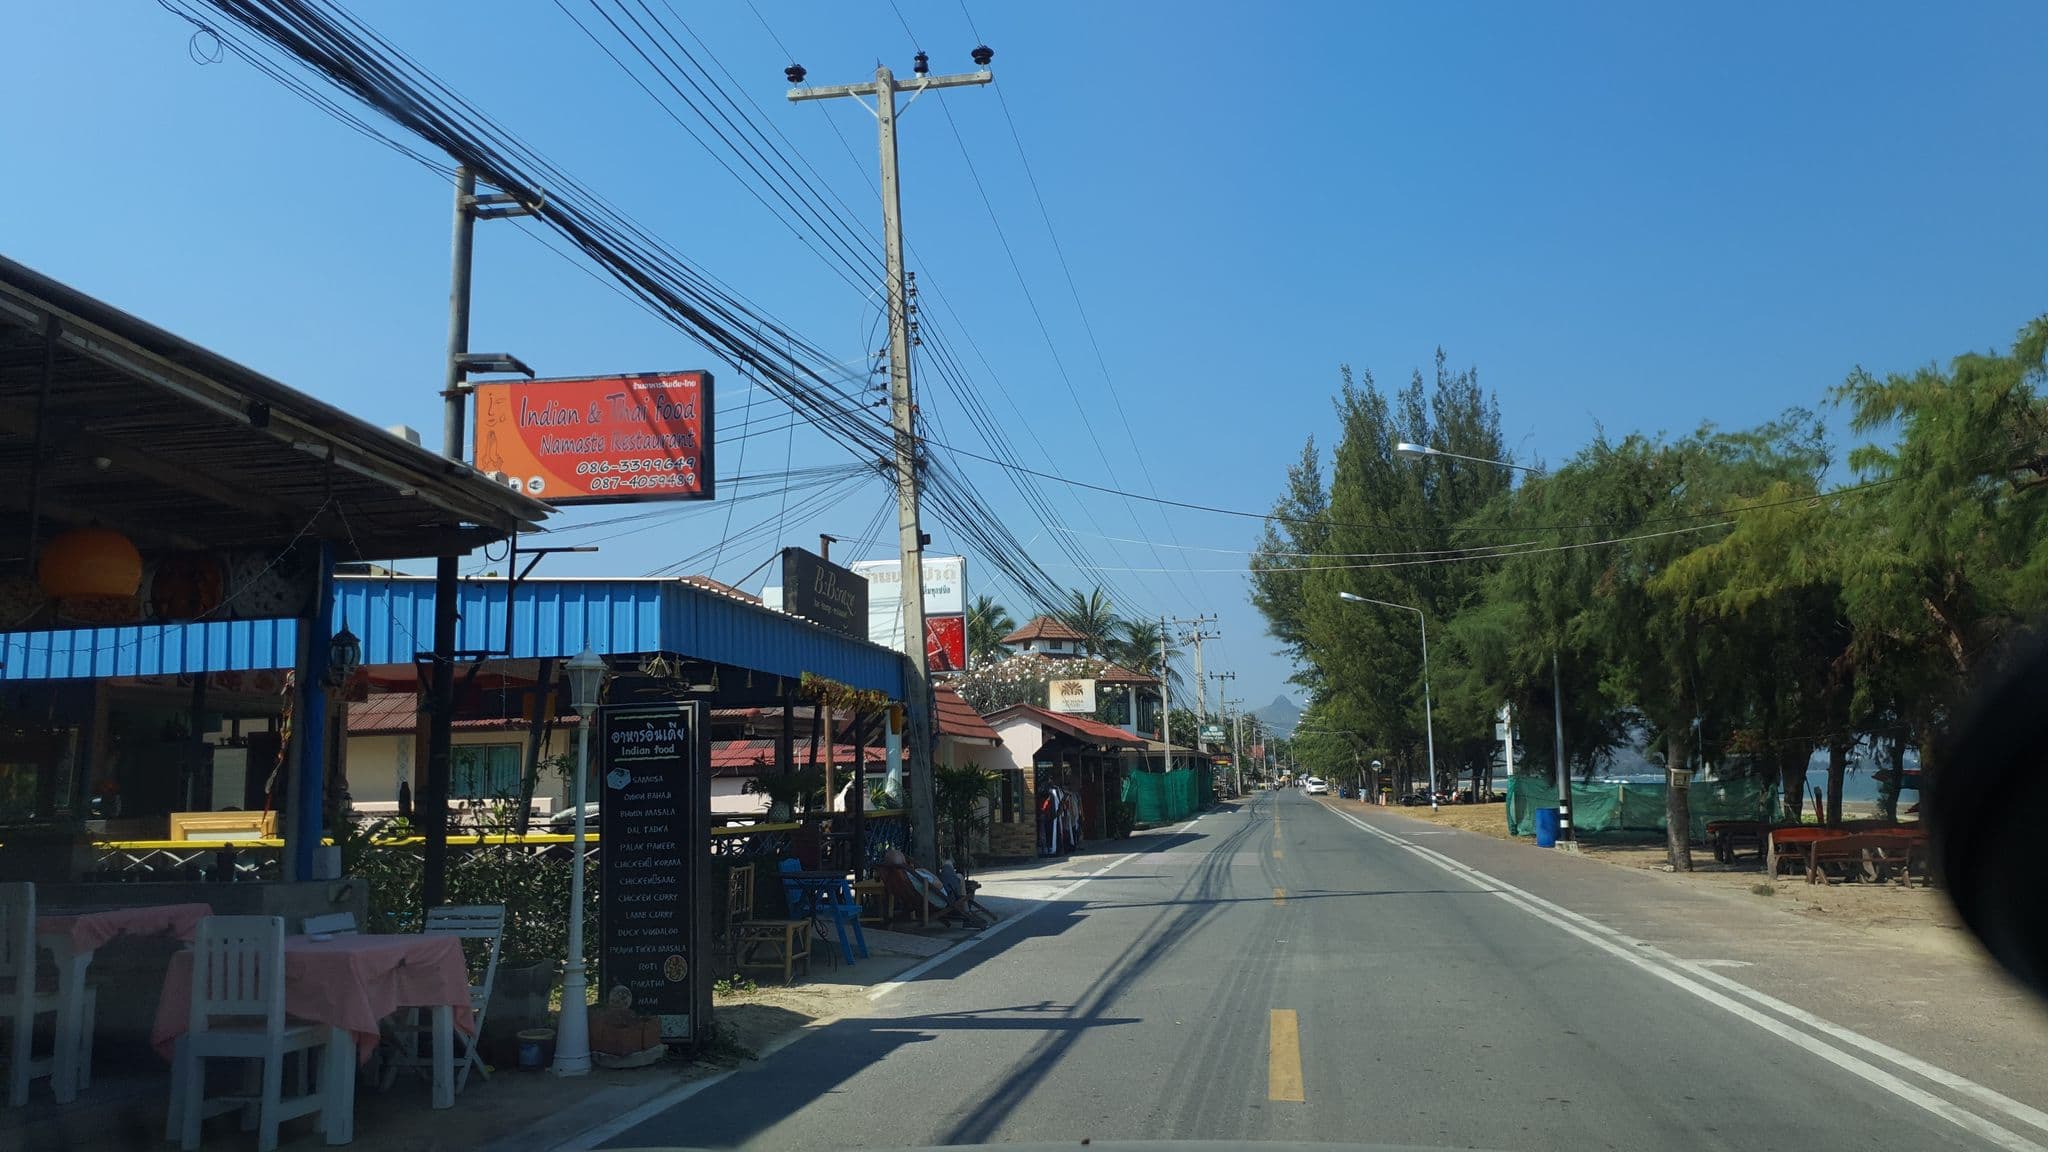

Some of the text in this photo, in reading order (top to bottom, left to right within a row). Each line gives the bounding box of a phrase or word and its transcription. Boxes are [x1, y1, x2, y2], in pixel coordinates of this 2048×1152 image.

[519, 392, 696, 430] Indian & Thai food
[539, 428, 696, 457] Namaste Restaurant
[576, 456, 696, 475] 086-3399649
[590, 473, 696, 491] 087-4059489
[611, 721, 687, 744] อาหารอินเดีย
[622, 744, 675, 756] Indian food
[632, 775, 664, 784] SAMOSA
[645, 808, 676, 817] MASALA
